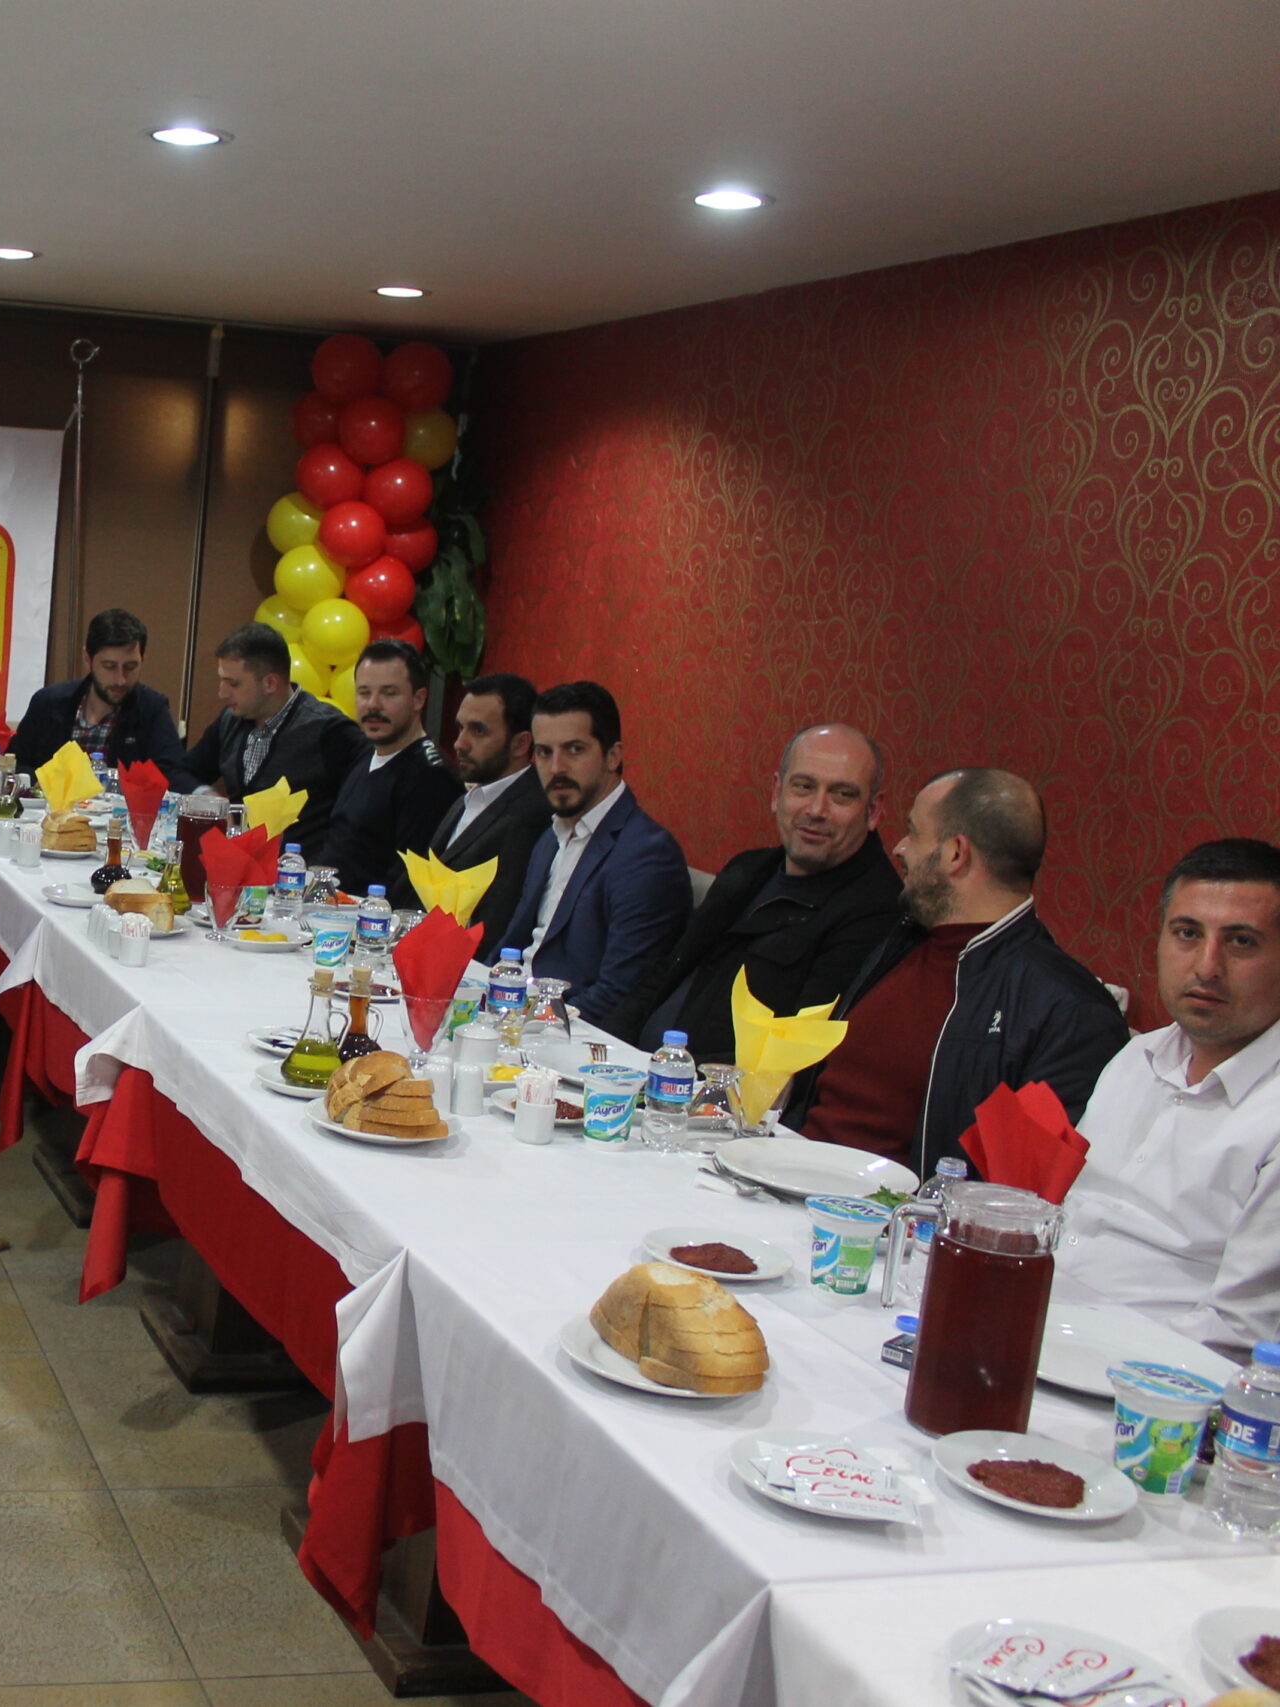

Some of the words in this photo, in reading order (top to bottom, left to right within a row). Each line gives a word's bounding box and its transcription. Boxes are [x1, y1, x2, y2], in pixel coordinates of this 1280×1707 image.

[661, 1082, 690, 1095] SUDE
[594, 1103, 625, 1117] Ayran
[1220, 1413, 1257, 1444] UDE
